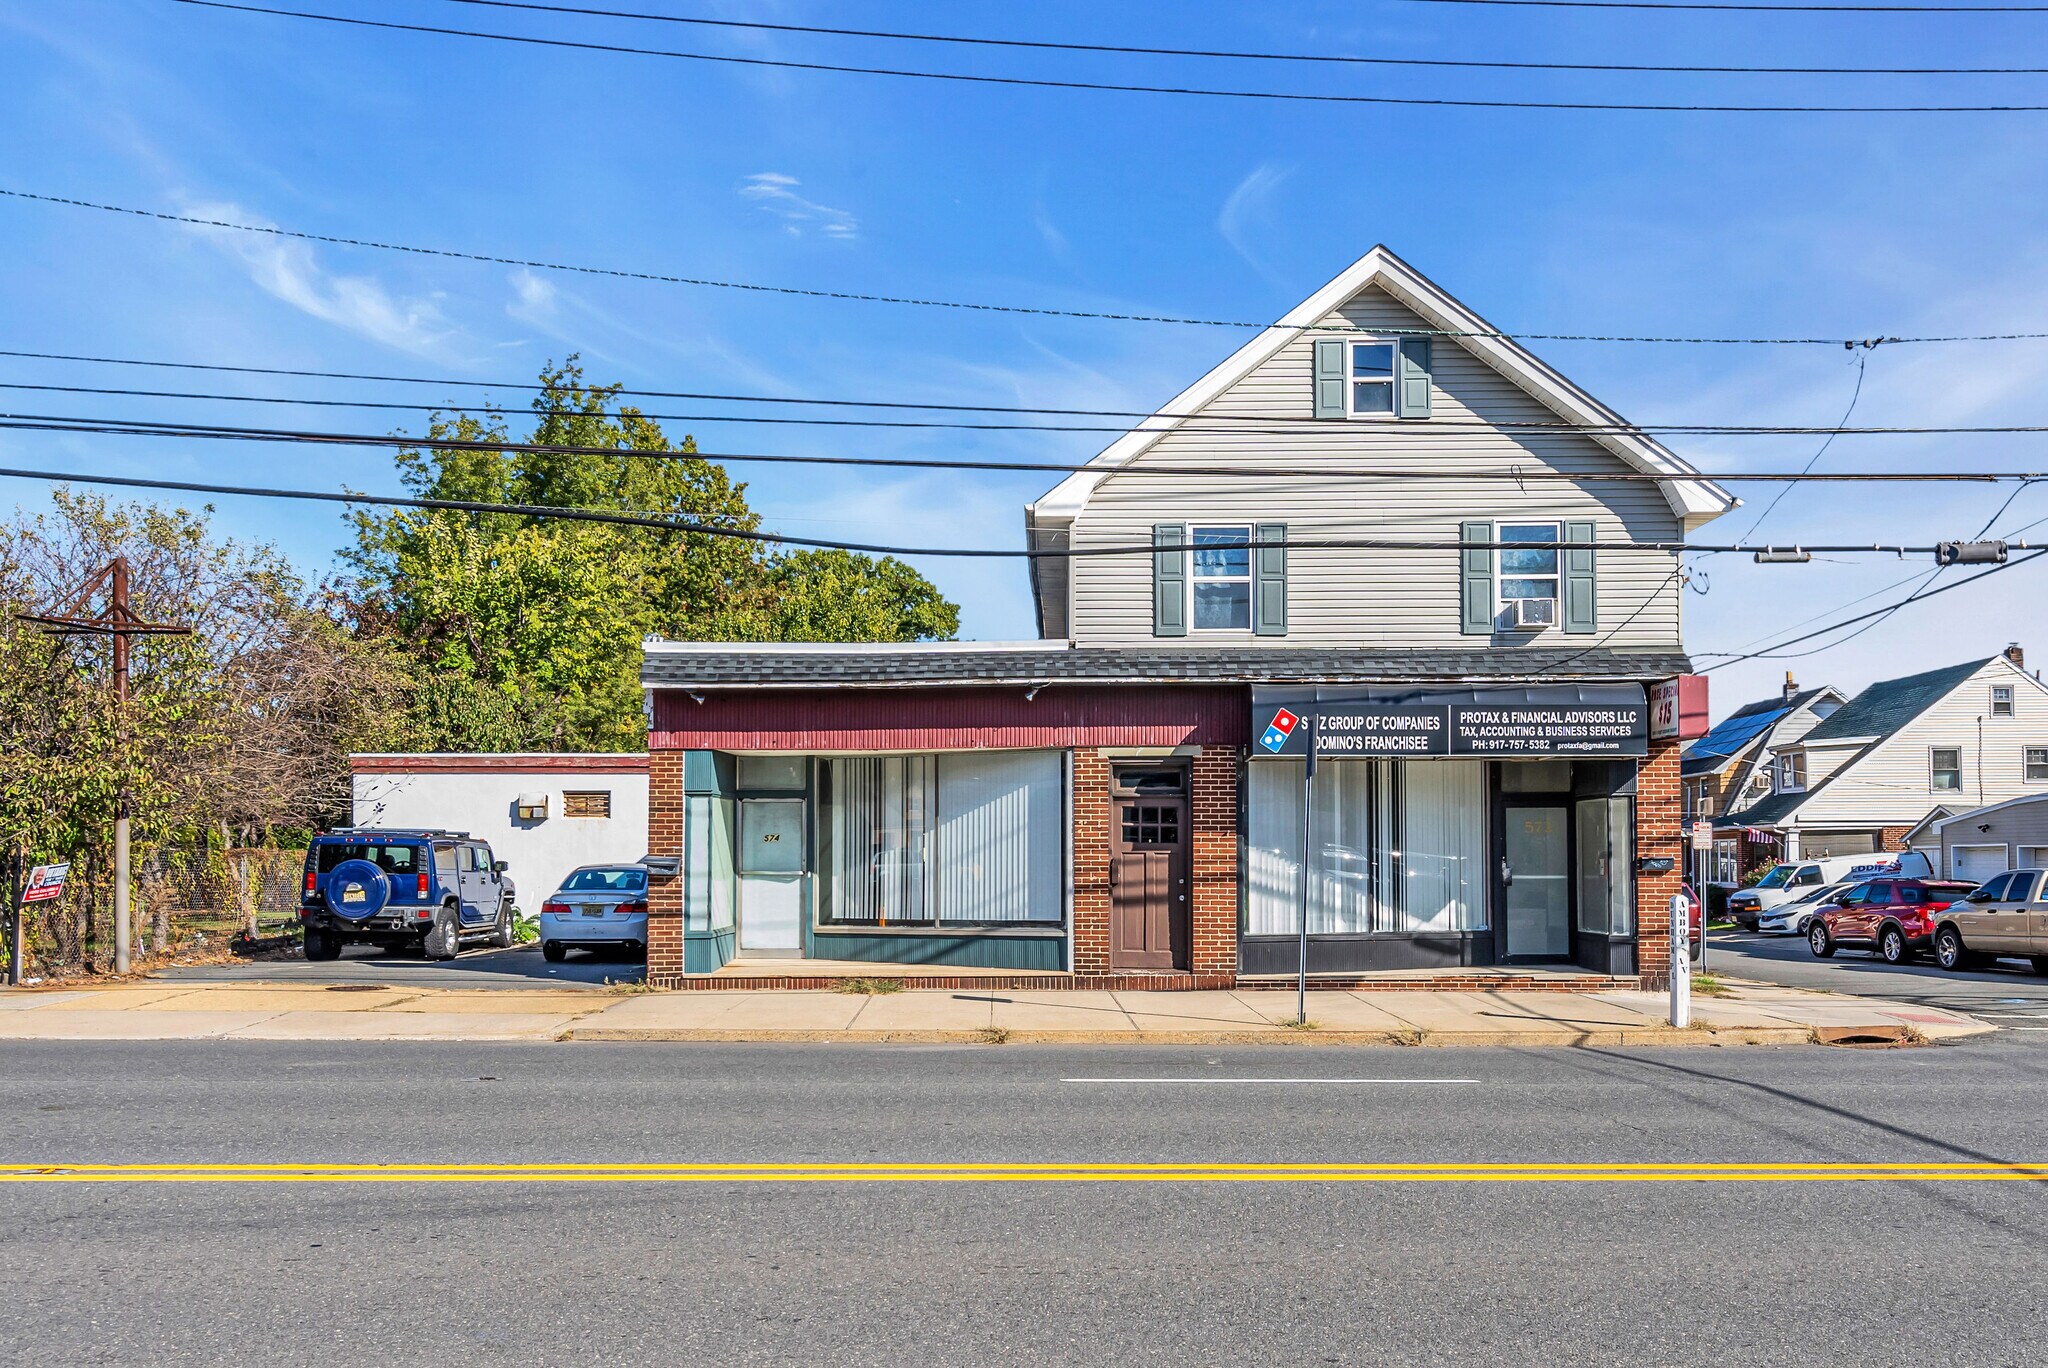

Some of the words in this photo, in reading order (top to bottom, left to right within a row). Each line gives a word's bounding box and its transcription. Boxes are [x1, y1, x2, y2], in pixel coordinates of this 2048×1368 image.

[1460, 711, 1500, 724] PROTAX
[1501, 711, 1510, 724] &
[1511, 711, 1563, 724] FINANCIAL
[1564, 711, 1617, 724] ADVISORS
[1617, 711, 1637, 723] LLC
[1658, 700, 1673, 725] $15
[1301, 716, 1326, 730] SZ
[1328, 716, 1365, 730] GROUP
[1366, 716, 1379, 730] OF
[1383, 716, 1440, 730] COMPANIES
[1459, 726, 1479, 738] TAX,
[1479, 726, 1536, 737] ACCOUNTING
[1537, 726, 1544, 736] &
[1545, 726, 1588, 737] BUSINESS
[1589, 726, 1632, 736] SERVICES
[1364, 735, 1428, 750] FRANCHISEE
[1489, 739, 1550, 750] 917-757-5382
[1557, 741, 1620, 751] protaxfa@gmail.com
[763, 834, 780, 842] 574
[1678, 901, 1686, 945] AMBOY
